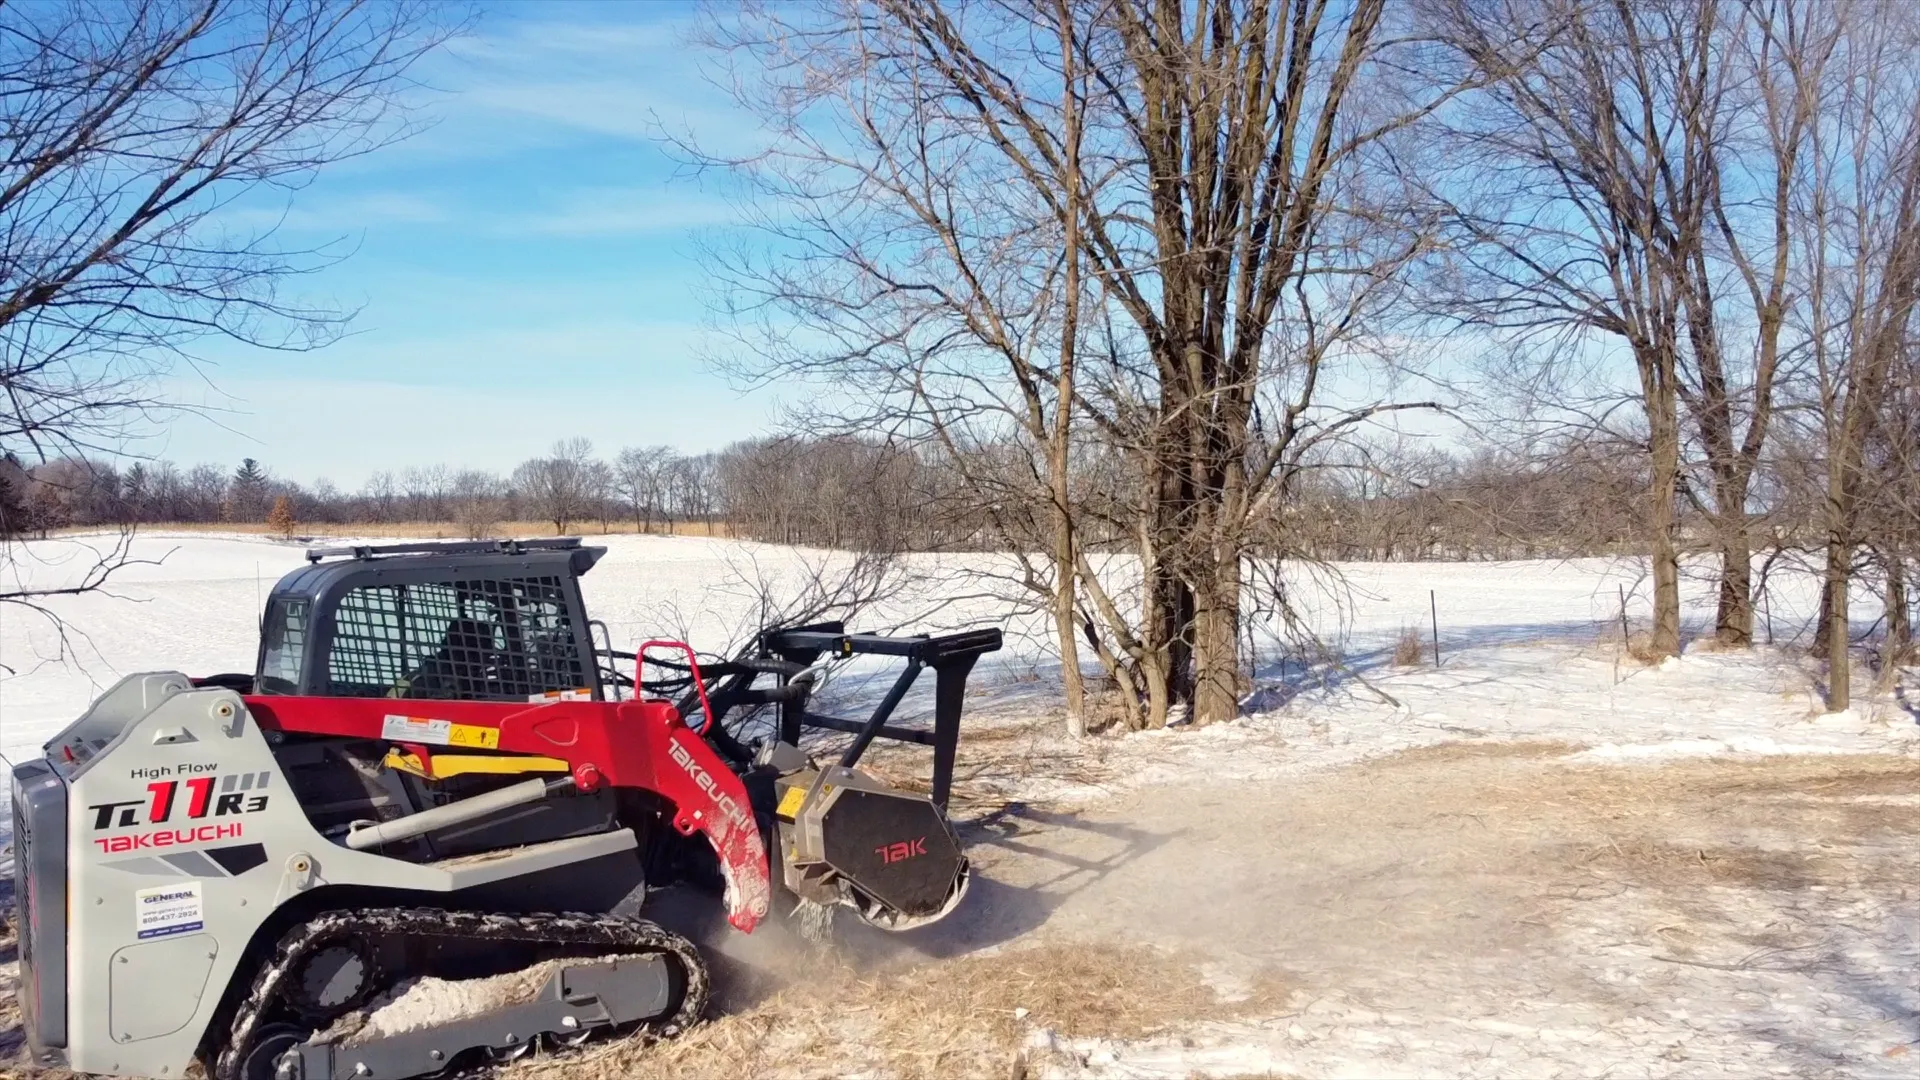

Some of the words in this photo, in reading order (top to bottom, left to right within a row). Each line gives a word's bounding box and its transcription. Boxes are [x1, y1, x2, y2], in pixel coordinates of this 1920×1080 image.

[131, 768, 171, 780] High
[177, 762, 218, 775] Flow
[668, 737, 750, 832] TAKEUCHI
[94, 823, 242, 853] TAKEUCHI
[143, 890, 194, 904] GENERAL
